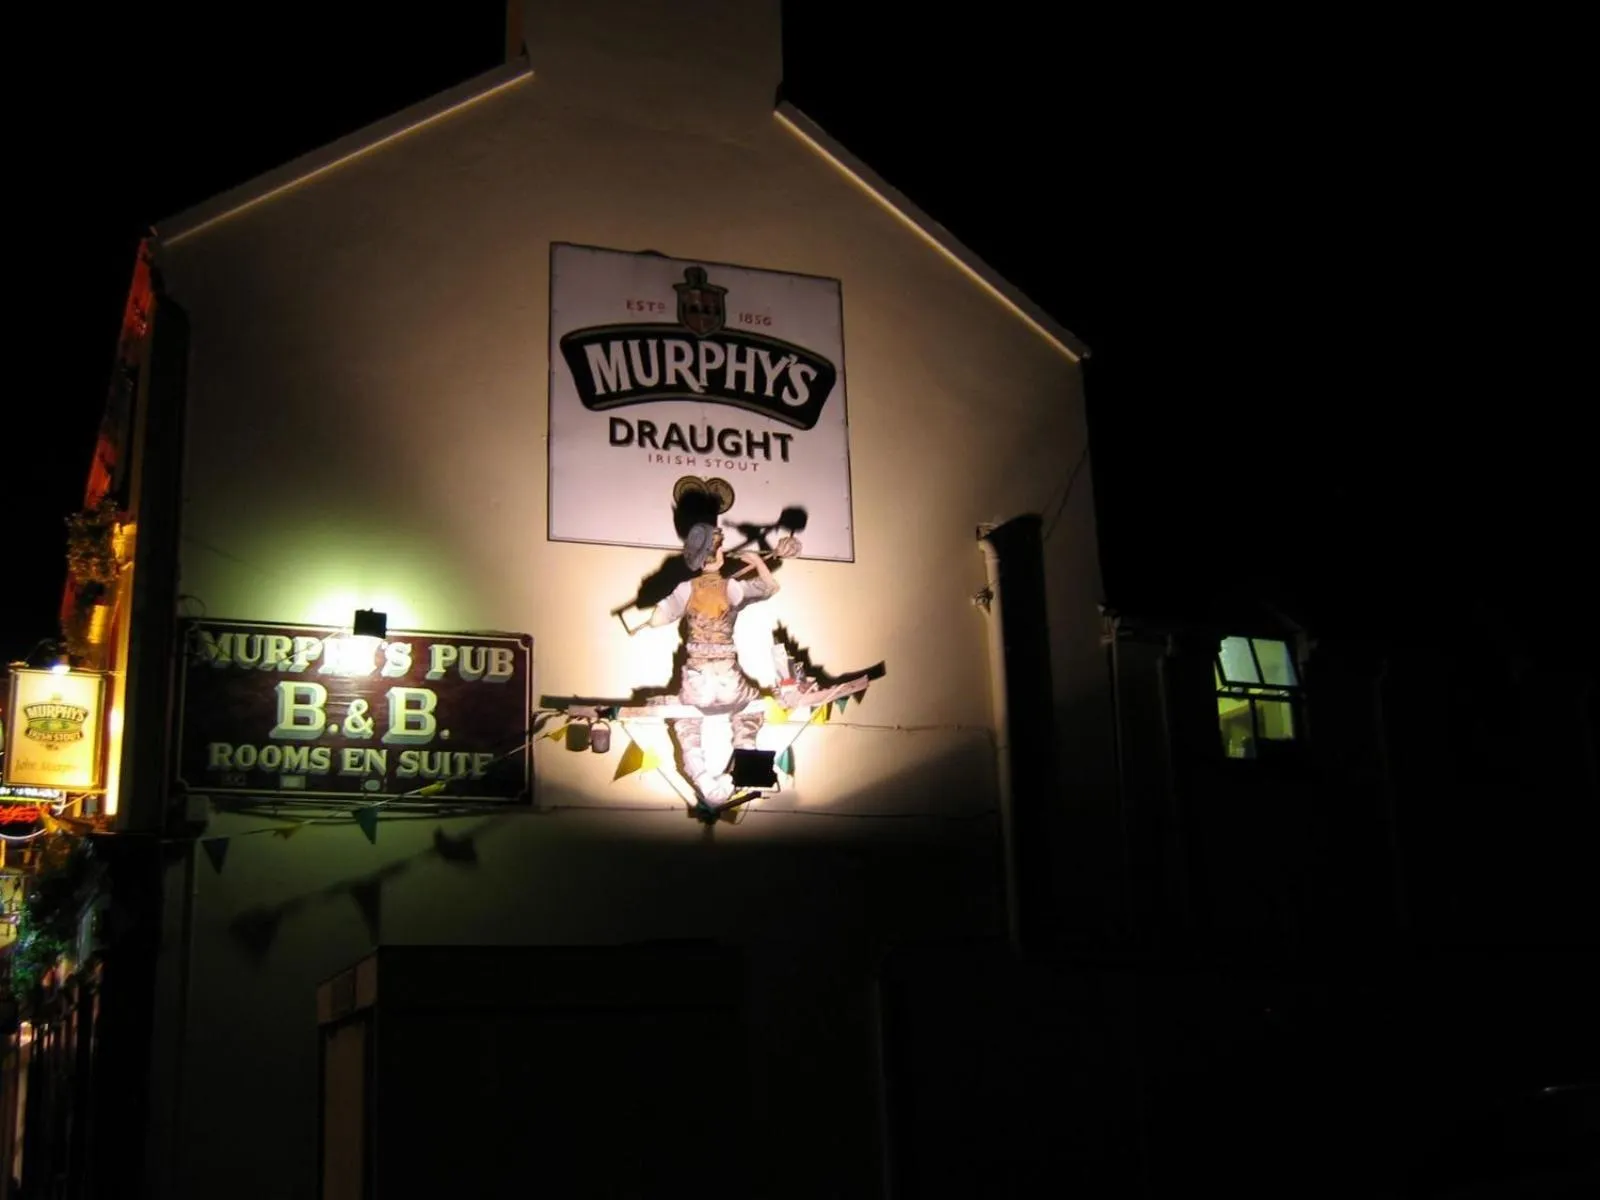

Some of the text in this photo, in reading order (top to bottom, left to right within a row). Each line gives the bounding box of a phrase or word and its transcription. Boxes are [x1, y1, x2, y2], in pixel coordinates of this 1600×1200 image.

[583, 338, 818, 407] MURPHY'S
[608, 416, 794, 463] DRAUGHT
[648, 453, 760, 473] IRISH STOUT
[426, 643, 516, 683] PUB
[206, 742, 495, 781] ROOMS EN SUITE
